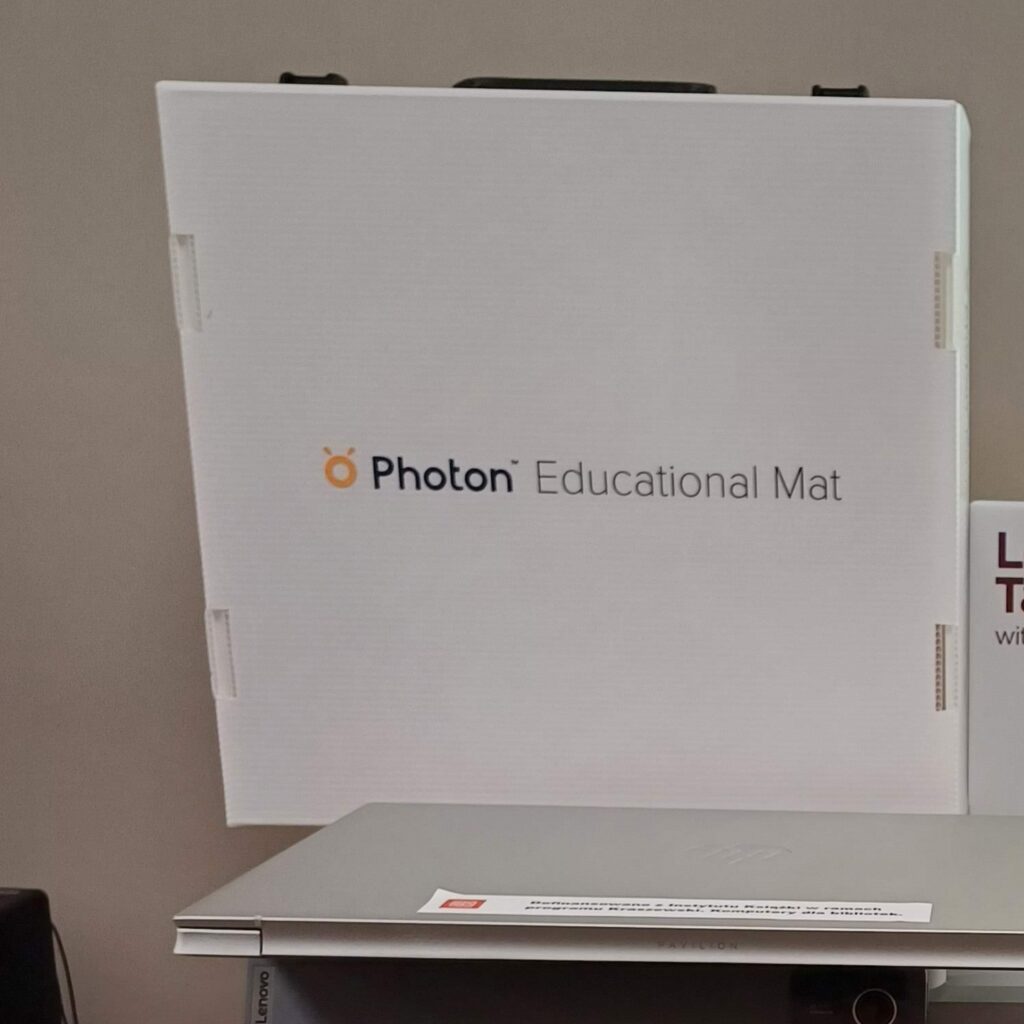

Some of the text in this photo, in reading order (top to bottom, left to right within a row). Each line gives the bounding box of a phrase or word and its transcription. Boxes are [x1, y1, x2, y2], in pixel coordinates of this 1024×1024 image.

[371, 455, 842, 502] Photon Educational Mat
[255, 970, 270, 1024] Lenovo
